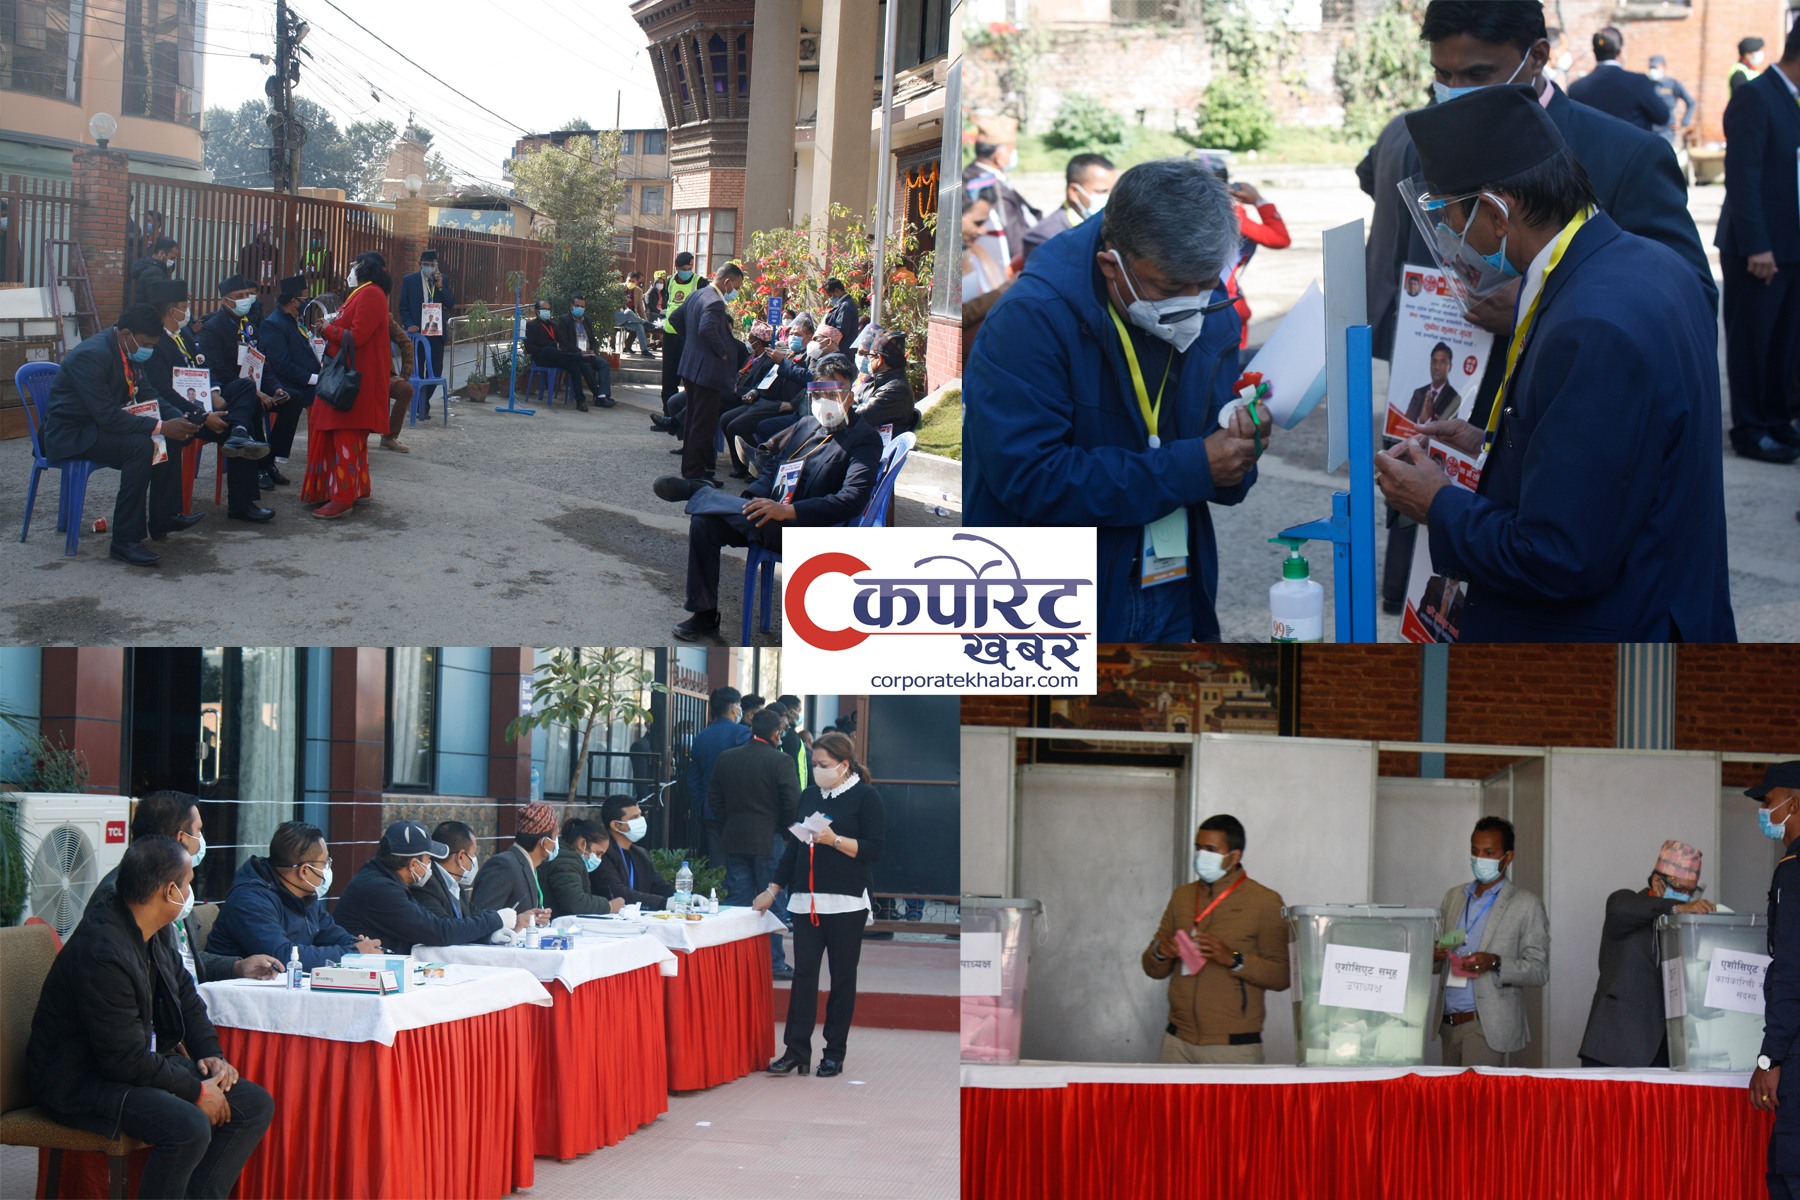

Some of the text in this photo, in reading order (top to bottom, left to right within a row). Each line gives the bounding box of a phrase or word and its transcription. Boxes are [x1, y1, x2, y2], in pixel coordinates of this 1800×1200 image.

[1273, 621, 1284, 637] 99
[108, 828, 123, 836] TCL
[1335, 962, 1397, 979] एशोसिएट समूह
[1346, 982, 1382, 992] उपाध्यक्ष
[1736, 992, 1757, 1000] सदस्य
